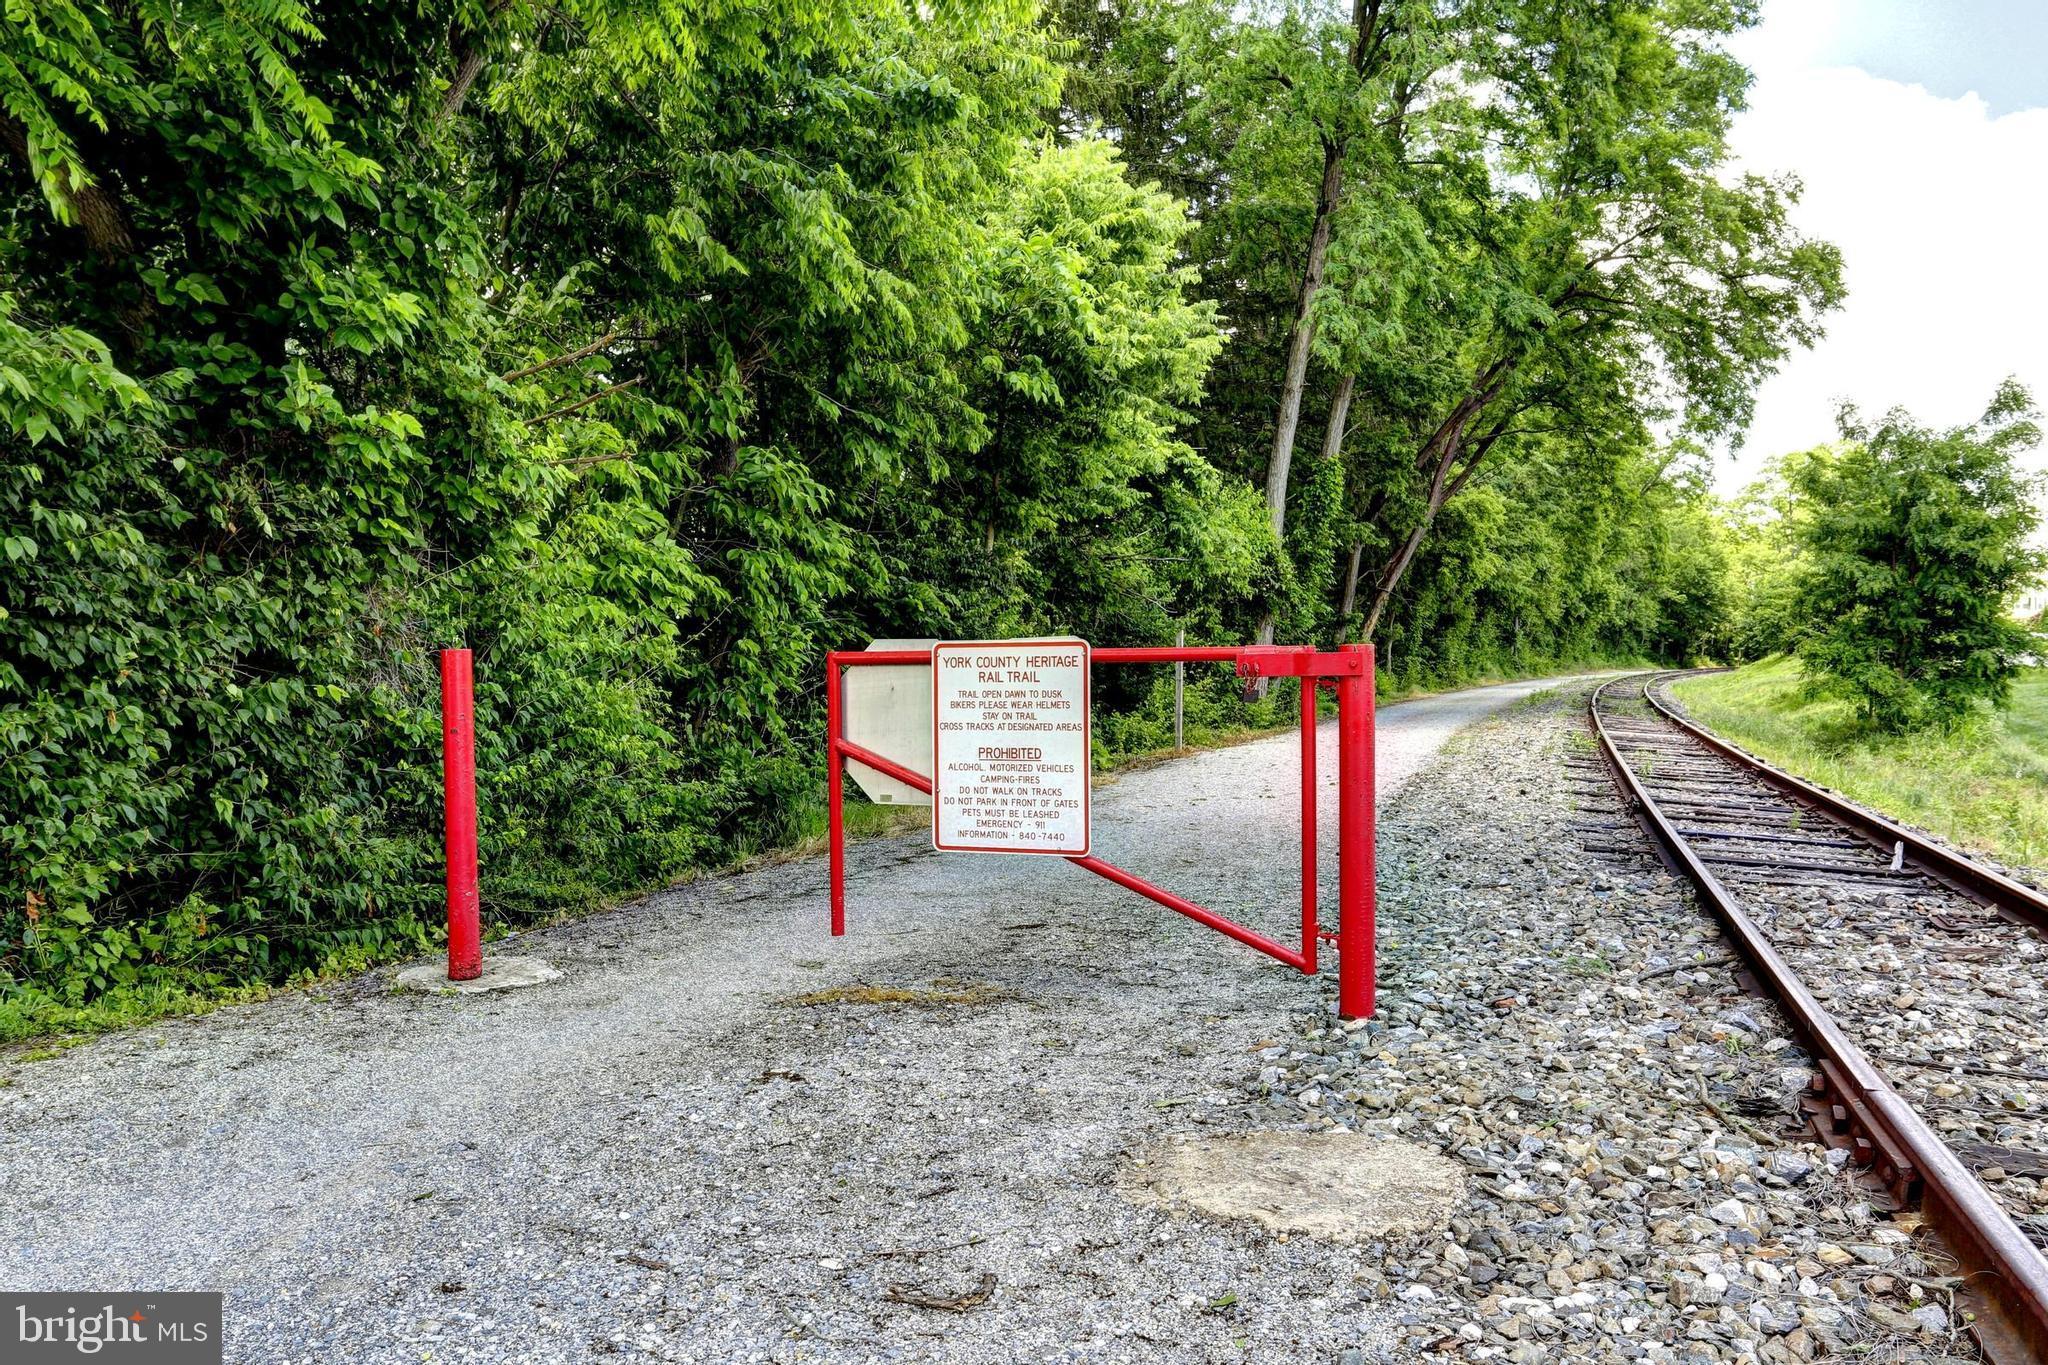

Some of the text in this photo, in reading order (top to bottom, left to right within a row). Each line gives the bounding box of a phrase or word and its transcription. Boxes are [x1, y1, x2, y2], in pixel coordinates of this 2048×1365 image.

[943, 656, 1078, 668] YORK COUNTY HERITAGE
[979, 672, 1040, 683] RAIL TRAIL
[959, 690, 1062, 698] TRAIL OPEN DAWN TO DUSK
[951, 701, 975, 709] BIKERS
[979, 701, 1007, 709] PLEASE
[982, 712, 1037, 720] STAY ON TRAIL
[998, 723, 1006, 731] AT
[1008, 723, 1053, 731] DESIGNATED
[1056, 723, 1082, 731] AREAS
[979, 747, 1042, 759] PROHIBITED
[990, 764, 1033, 772] MOTORIZED
[1037, 764, 1074, 772] VEHICLES
[959, 786, 970, 794] DO
[992, 787, 1013, 795] WALK
[1032, 788, 1062, 796] TRACKS
[944, 797, 1078, 808] DO NOT PARK IN FRONT OF GATES
[962, 808, 1060, 818] PETS MUST BE LEASHED
[977, 820, 1023, 828] EMERGENCY
[1035, 821, 1045, 829] 911
[958, 830, 1008, 839] INFORMATION
